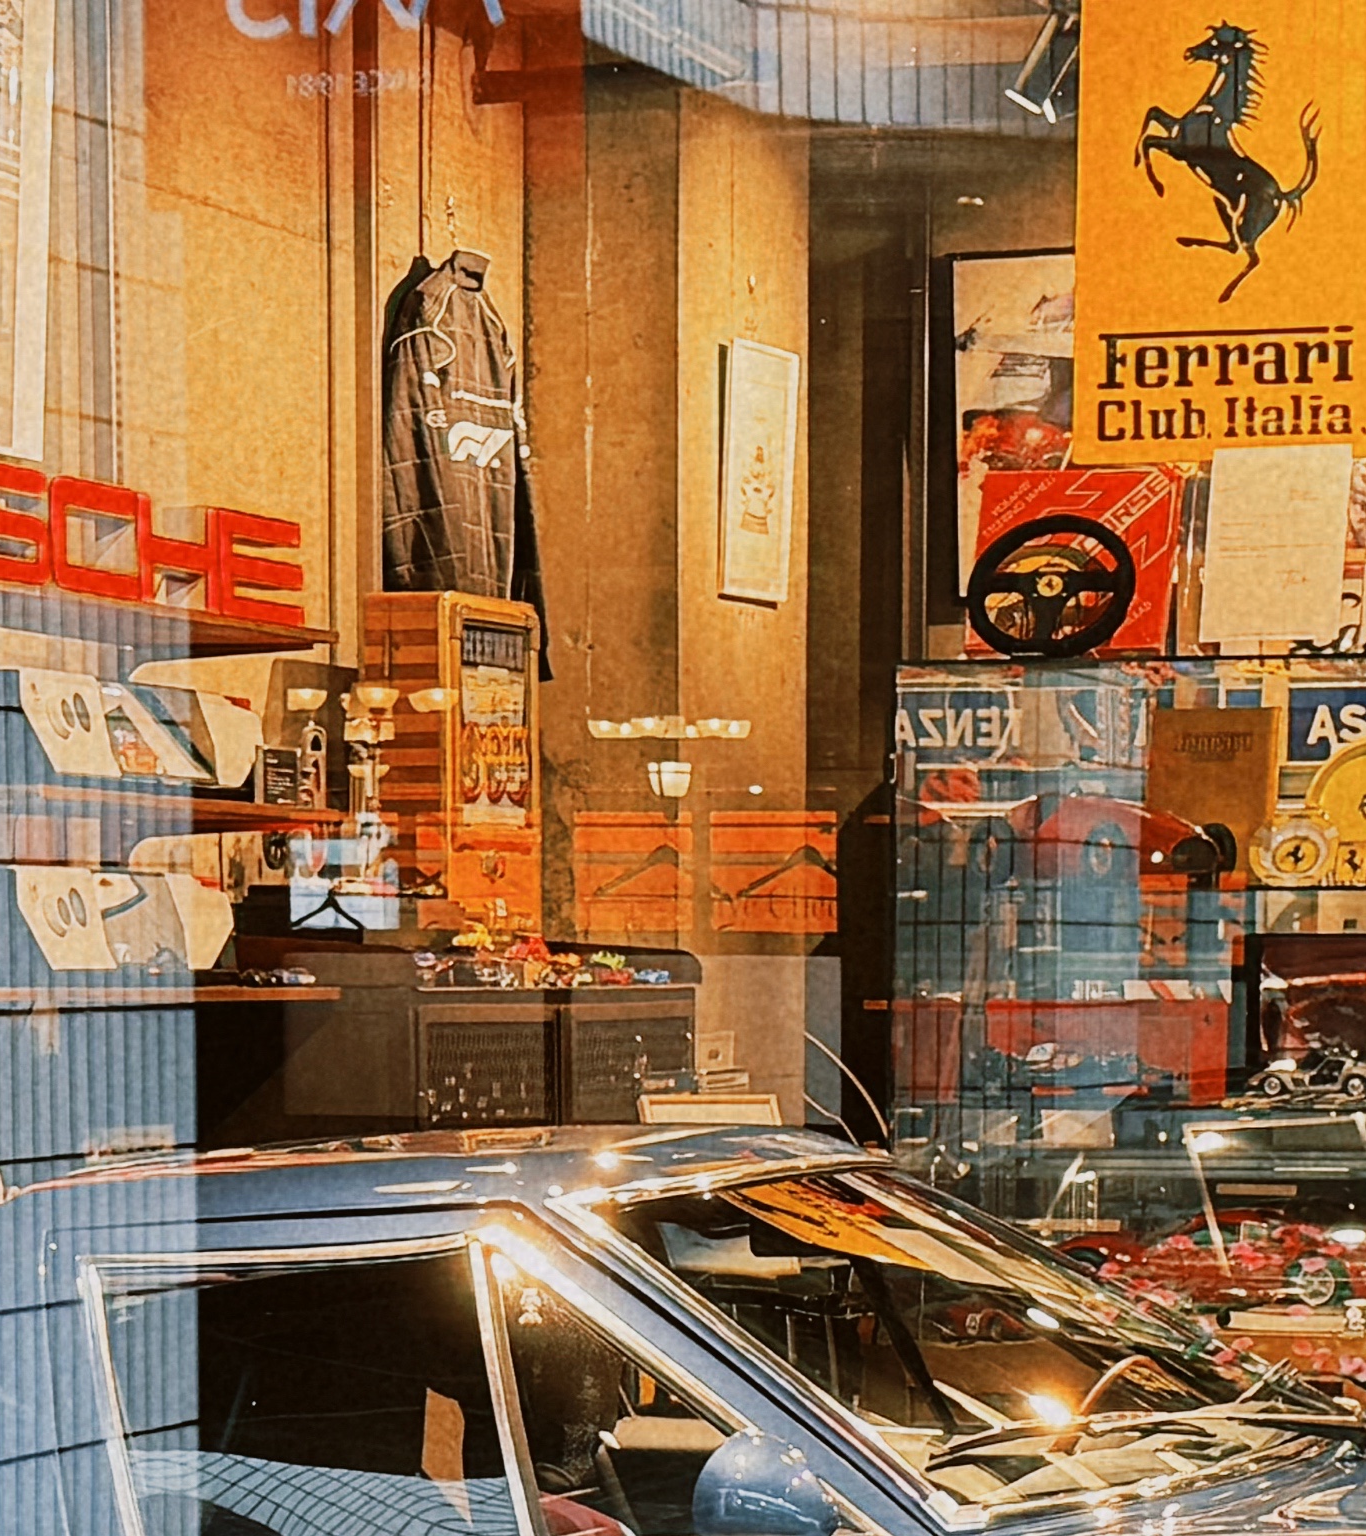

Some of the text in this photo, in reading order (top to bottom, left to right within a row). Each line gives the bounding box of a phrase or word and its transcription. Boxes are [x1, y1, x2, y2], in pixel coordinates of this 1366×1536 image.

[1097, 325, 1354, 389] Ferrari
[1097, 395, 1352, 441] Club Italia
